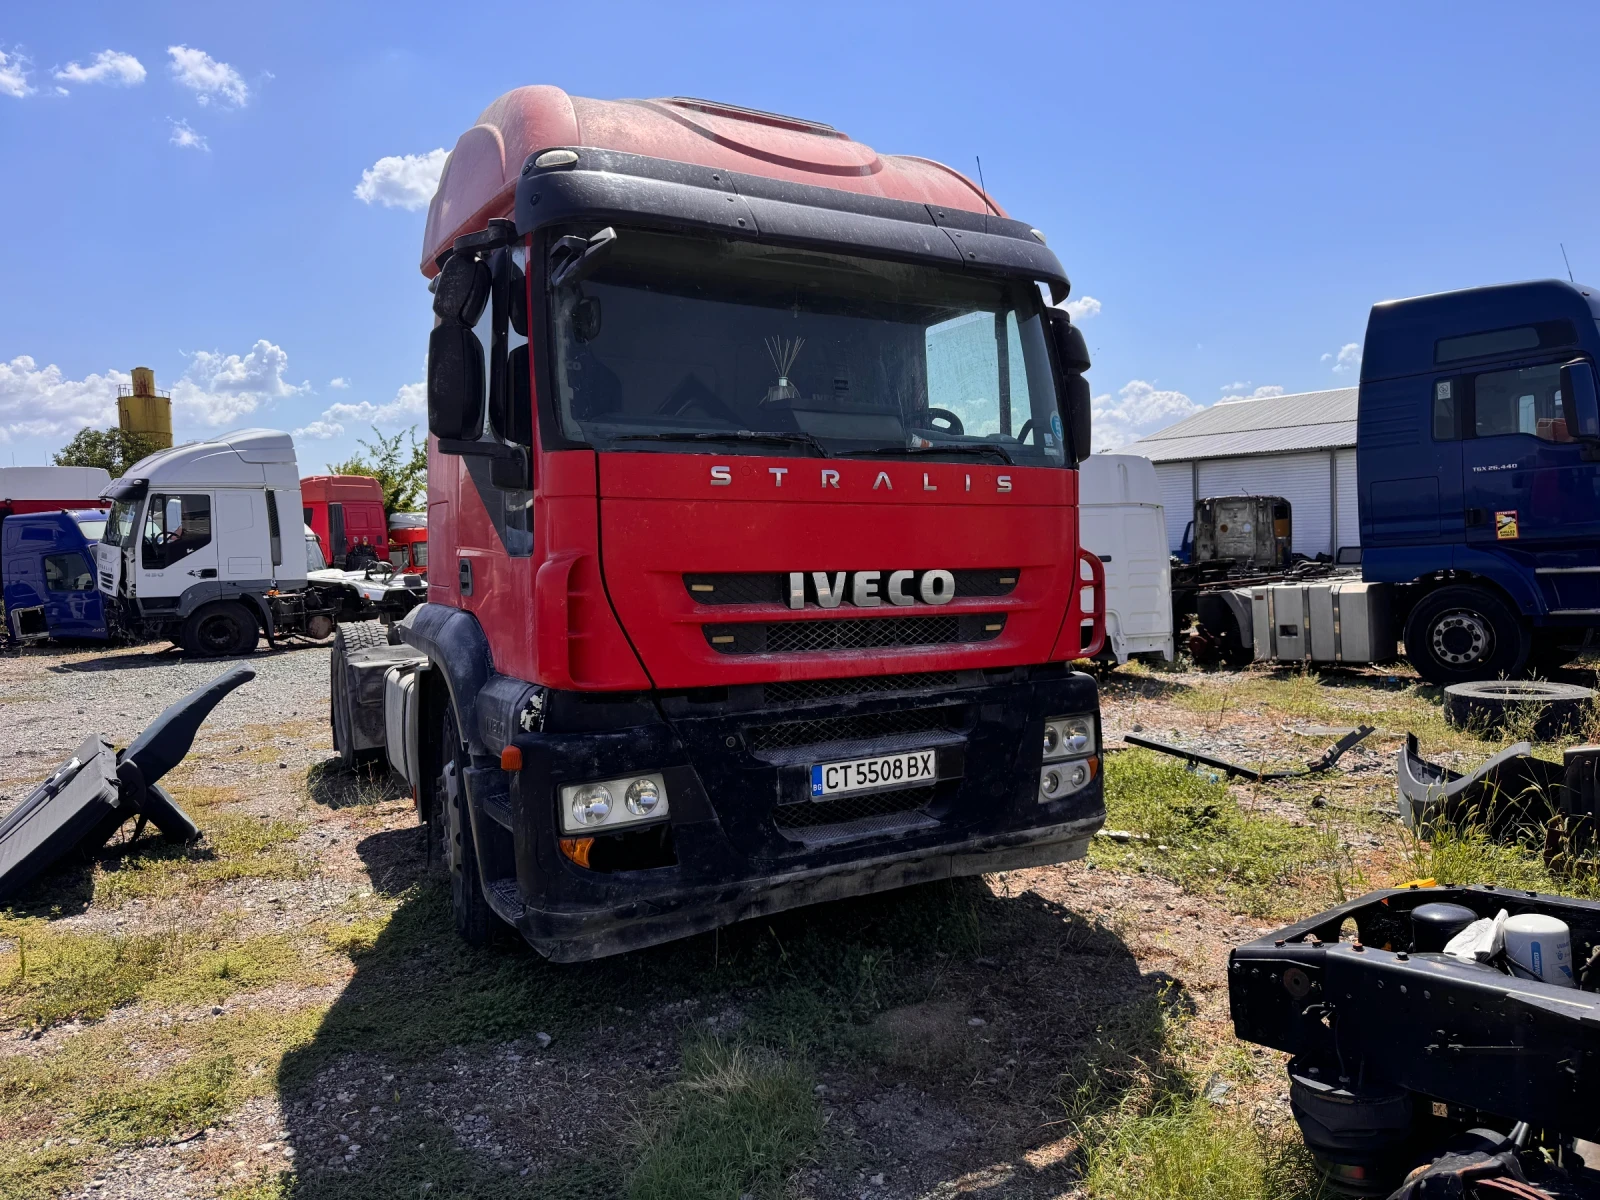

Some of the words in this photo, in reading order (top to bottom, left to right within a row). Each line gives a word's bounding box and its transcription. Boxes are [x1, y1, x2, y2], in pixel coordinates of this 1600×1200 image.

[710, 465, 1012, 493] STRALIS
[1488, 463, 1518, 471] 26.440
[789, 569, 955, 610] IVECO
[826, 764, 852, 789] CT
[856, 758, 903, 785] 5508
[908, 754, 931, 778] BX
[813, 783, 822, 792] BG
